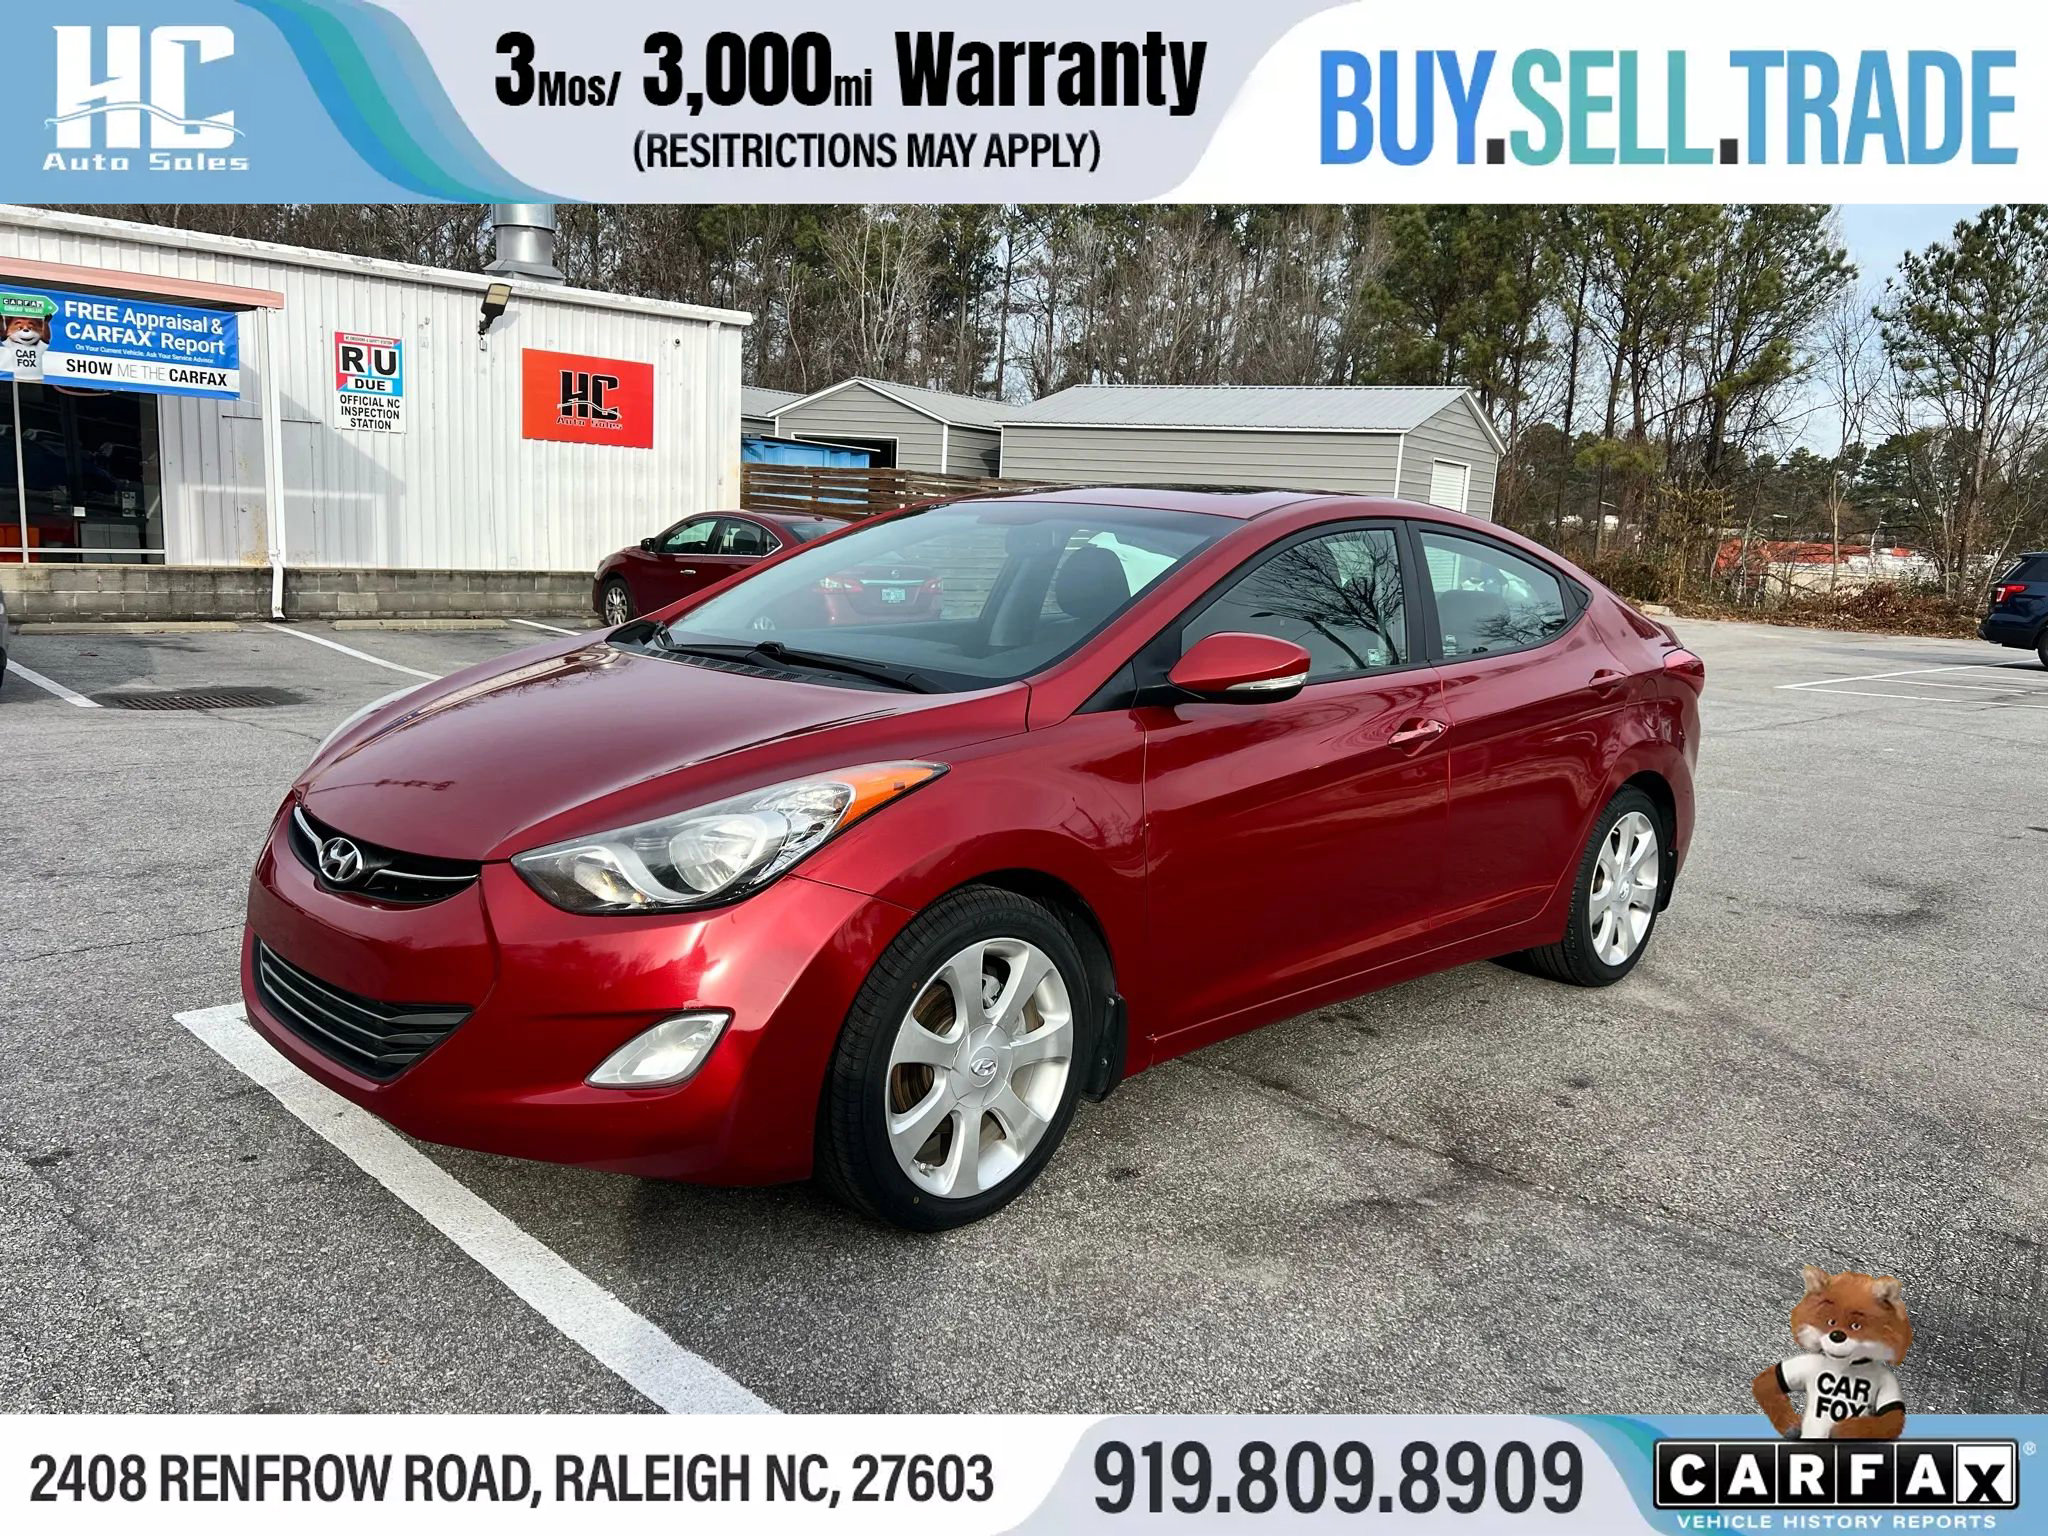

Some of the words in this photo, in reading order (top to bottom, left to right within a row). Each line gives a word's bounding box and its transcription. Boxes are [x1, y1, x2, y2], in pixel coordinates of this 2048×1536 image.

[64, 300, 119, 323] FREE
[122, 308, 208, 333] Appraisal
[211, 318, 224, 335] &
[161, 332, 226, 355] Report
[16, 349, 36, 358] CAR
[17, 359, 37, 367] FOX
[66, 358, 113, 375] SHOW
[117, 363, 138, 379] ME
[140, 366, 166, 381] THE
[169, 368, 227, 387] CARFAX
[354, 378, 386, 391] DUE
[340, 394, 384, 407] OFFICIAL
[387, 398, 401, 409] NC
[341, 405, 400, 420] INSPECTION
[350, 417, 392, 430] STATION
